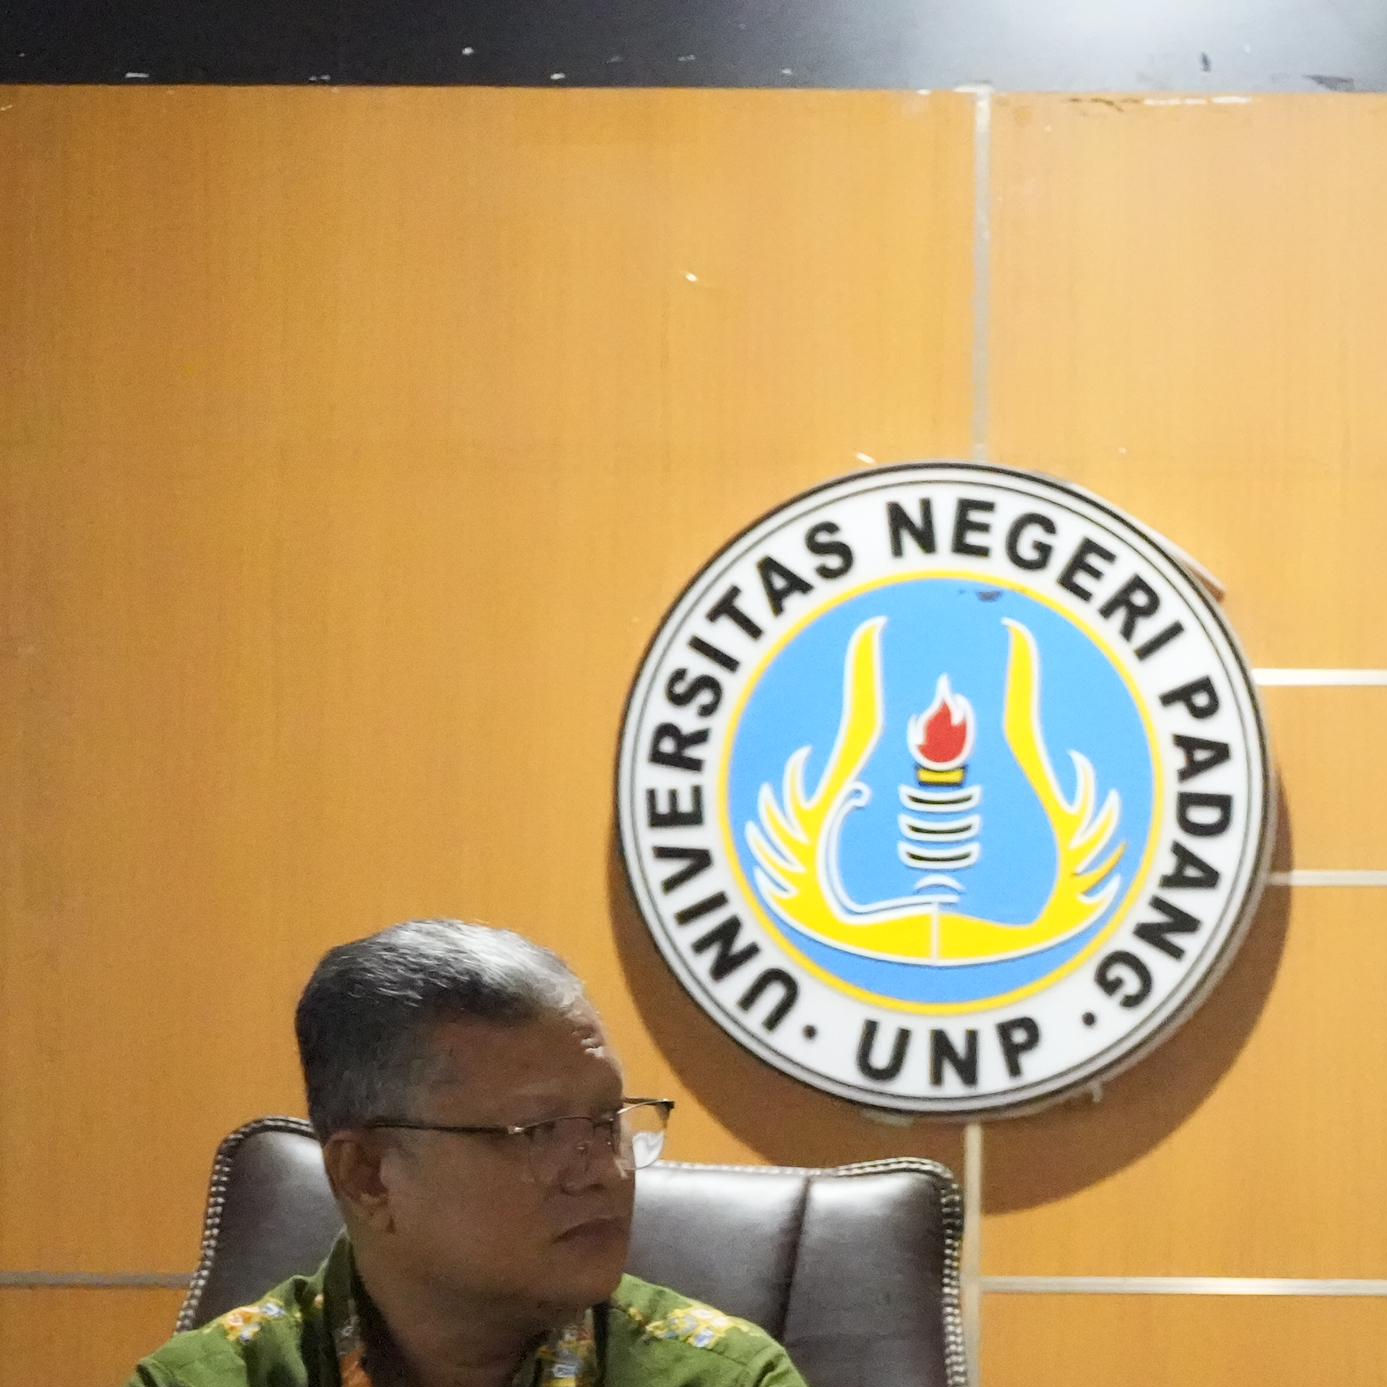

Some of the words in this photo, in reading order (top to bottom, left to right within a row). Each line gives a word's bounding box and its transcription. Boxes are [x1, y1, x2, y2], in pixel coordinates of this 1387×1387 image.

[647, 520, 855, 1032] UNIVERSITAS
[886, 497, 1186, 661] NEGERI
[1093, 676, 1233, 1010] PADANG
[856, 1016, 1042, 1088] UNP
